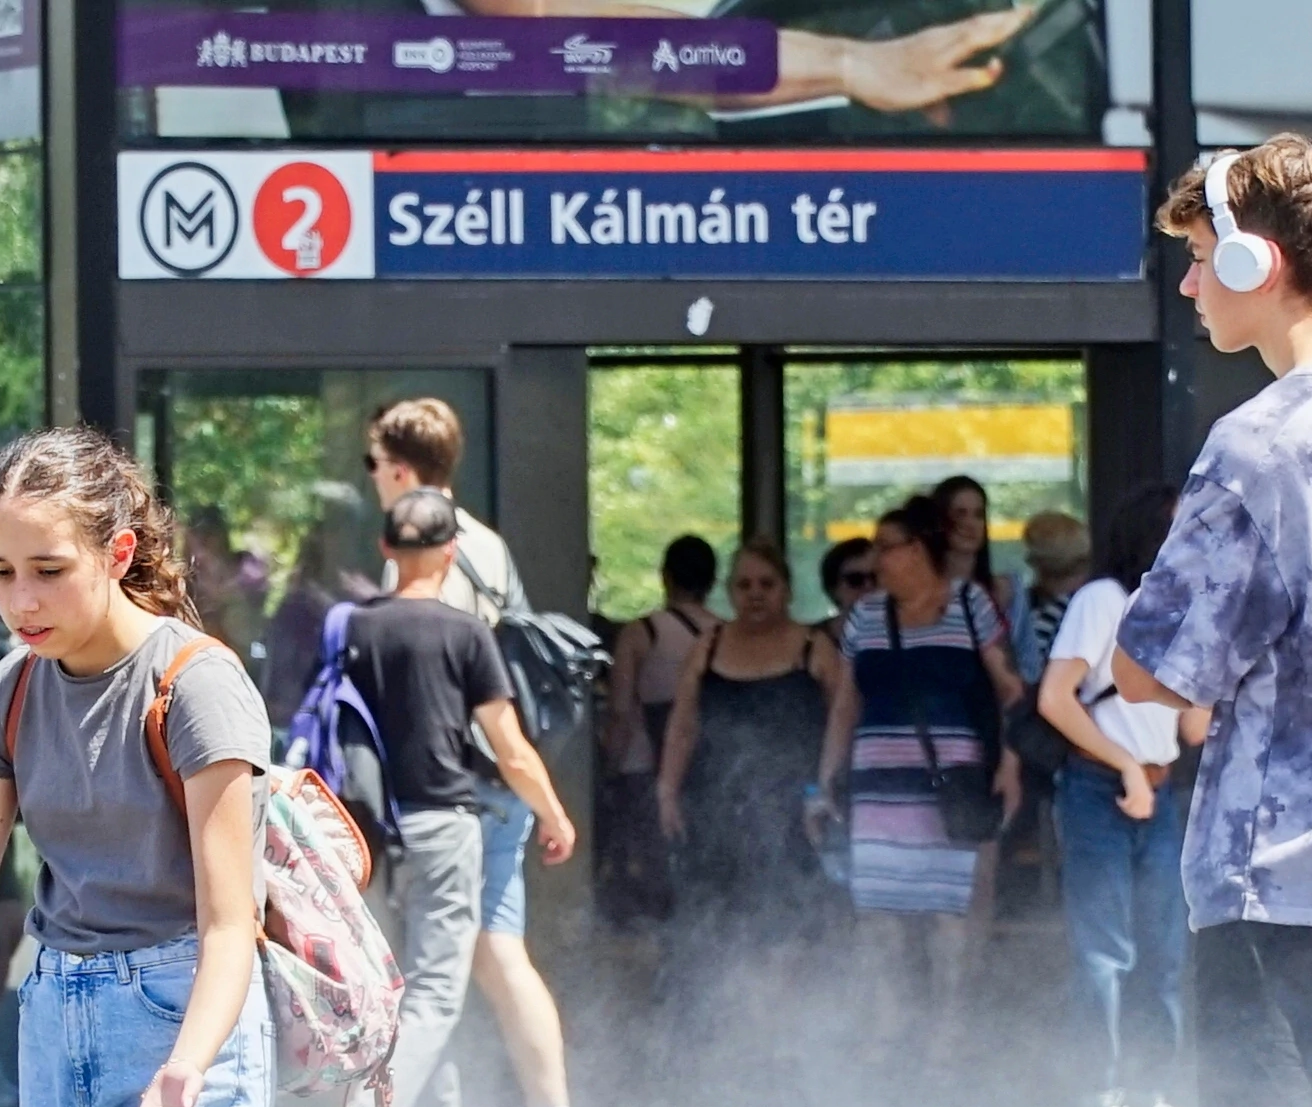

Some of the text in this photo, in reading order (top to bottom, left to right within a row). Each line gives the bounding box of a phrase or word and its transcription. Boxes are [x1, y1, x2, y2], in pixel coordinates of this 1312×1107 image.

[249, 41, 368, 65] BUDAPEST
[282, 185, 323, 251] 2
[388, 188, 525, 246] Széll
[549, 188, 770, 246] Kálmán
[791, 187, 878, 245] tér
